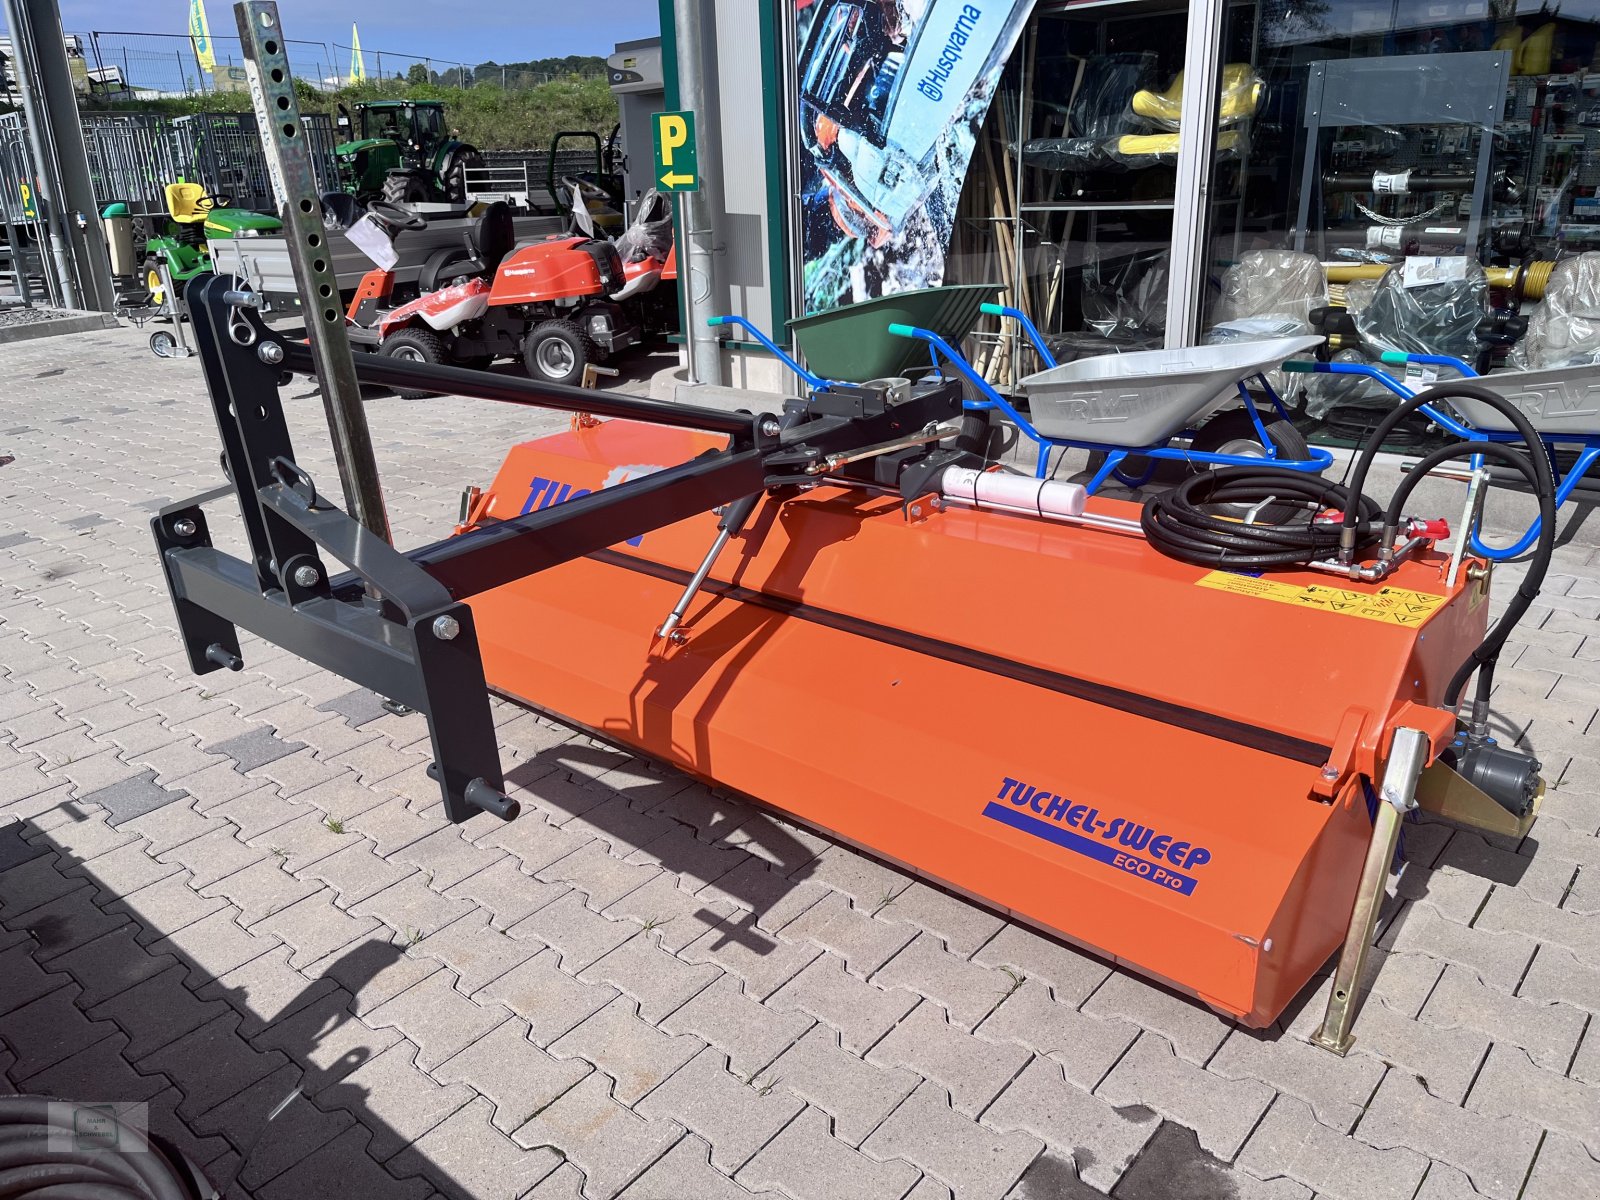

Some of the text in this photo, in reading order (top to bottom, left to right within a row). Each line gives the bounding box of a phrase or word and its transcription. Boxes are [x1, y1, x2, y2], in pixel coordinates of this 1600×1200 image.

[925, 4, 982, 88] Husqvarna
[660, 115, 687, 165] P
[20, 184, 30, 207] P
[997, 776, 1212, 870] TUCHEL-SWEEP
[1112, 853, 1183, 889] ECO Pro
